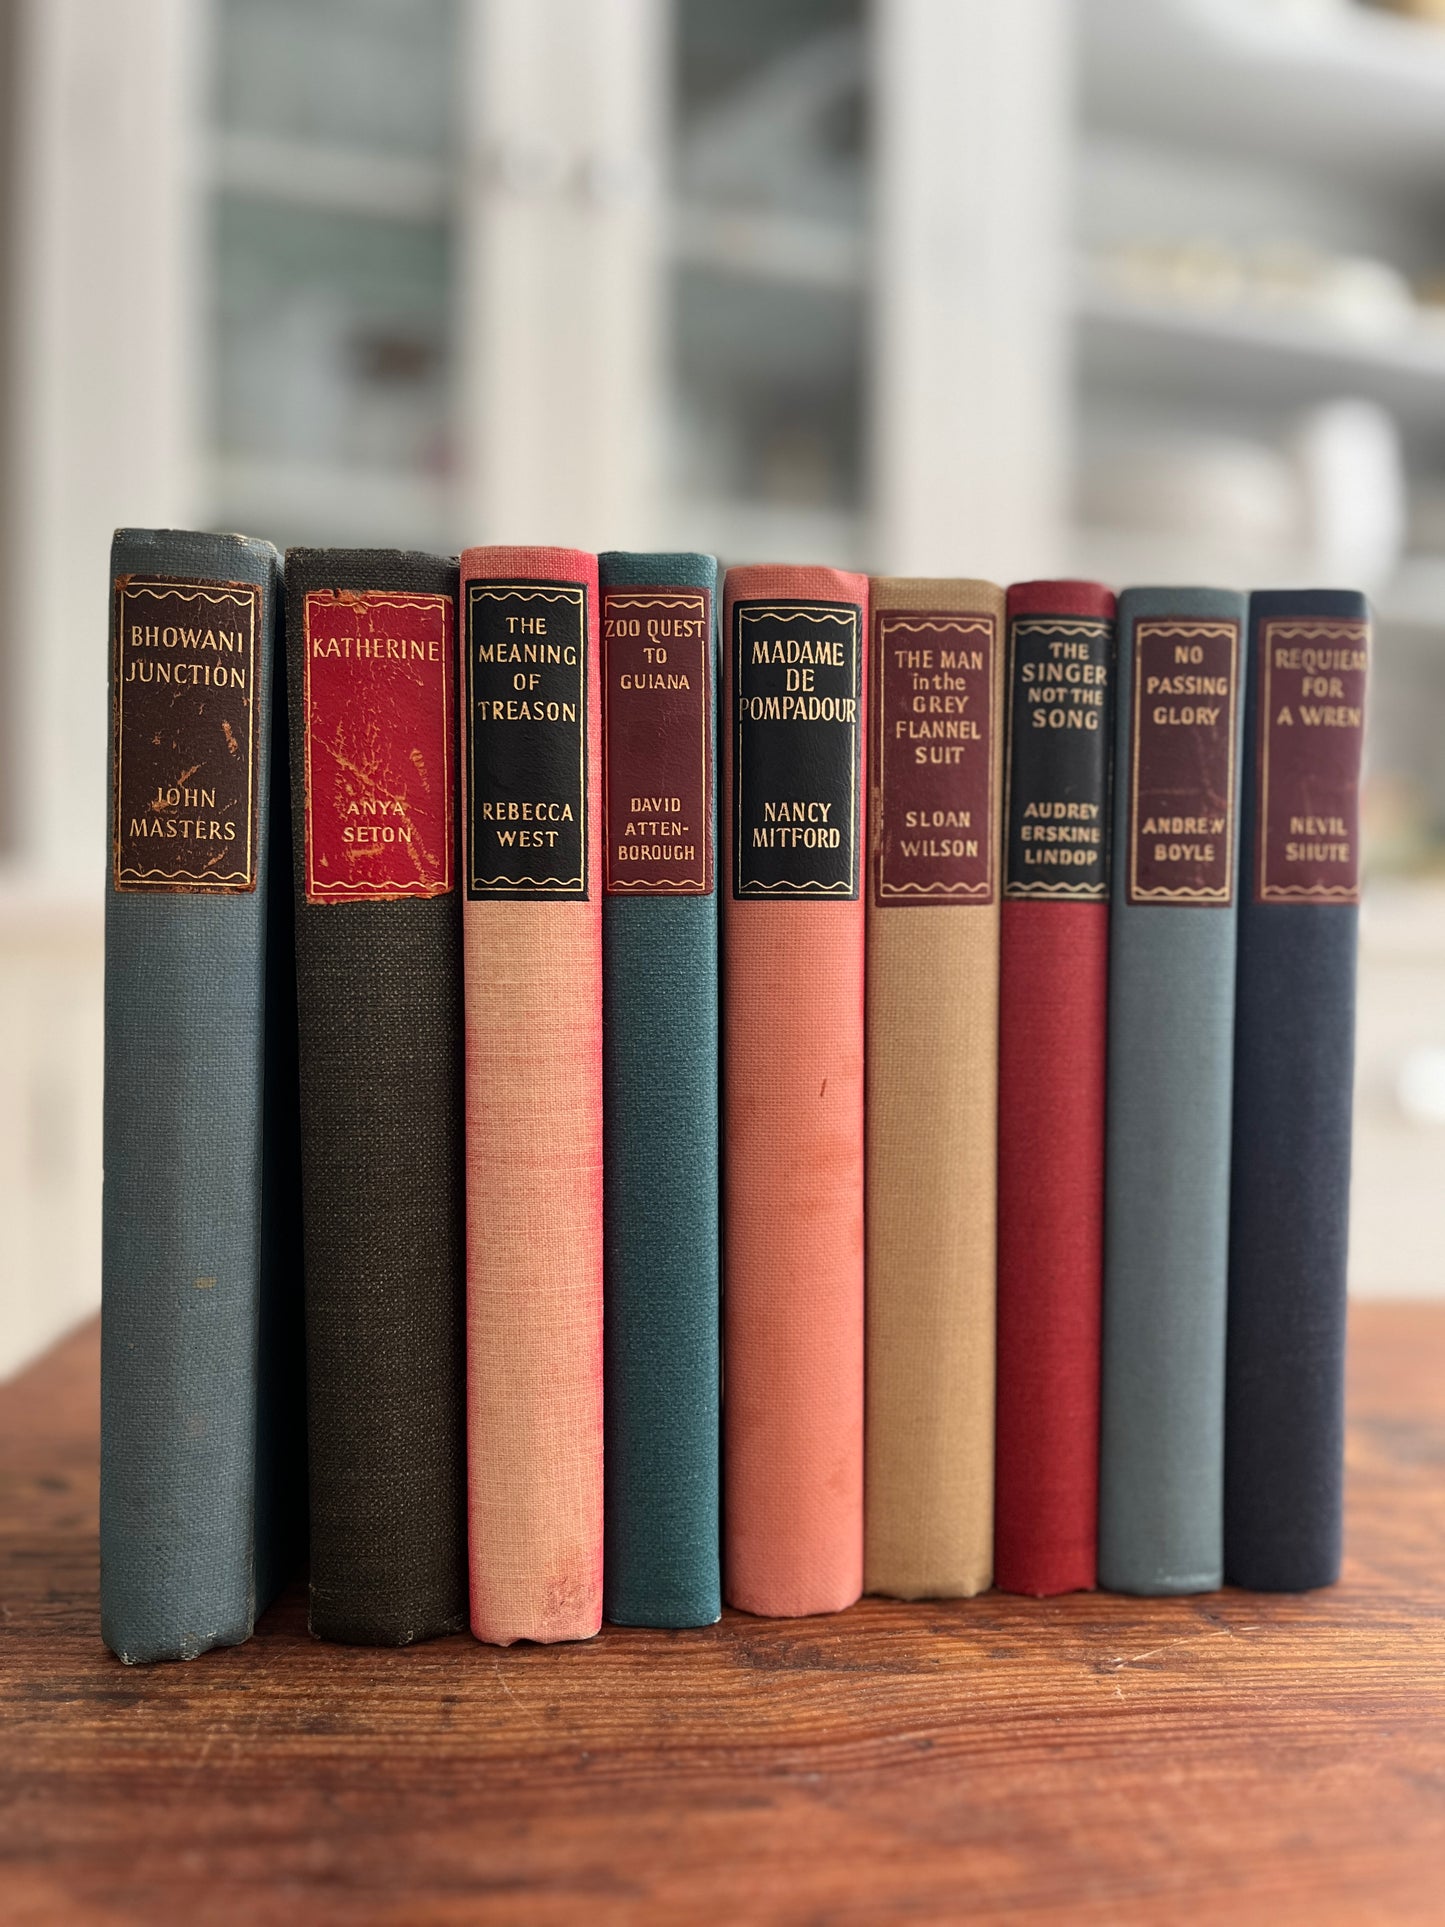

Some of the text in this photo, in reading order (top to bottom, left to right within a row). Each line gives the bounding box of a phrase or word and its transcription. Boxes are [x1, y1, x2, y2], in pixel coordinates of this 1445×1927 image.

[506, 617, 547, 635] THE
[605, 620, 705, 643] ZOO QUEST
[131, 627, 243, 653] BHOWANI
[313, 638, 440, 661] KATHERINE
[479, 644, 576, 665] MEANING
[643, 648, 667, 663] TO
[752, 640, 844, 666] MADAME
[894, 650, 983, 670] THE MAN
[1049, 642, 1090, 660] THE
[1175, 646, 1203, 664] NO
[1276, 648, 1366, 674] REQUIEM
[126, 663, 245, 688] JUNCTION
[513, 674, 541, 690] OF
[621, 674, 690, 689] GUIANA
[786, 668, 814, 692] DE
[913, 672, 966, 691] in the
[1022, 663, 1107, 685] SINGER
[1147, 676, 1228, 696] PASSING
[1302, 676, 1344, 698] FOR
[913, 696, 968, 714] GREY
[1028, 687, 1104, 706] NOT THE
[478, 701, 576, 722] TREASON
[739, 697, 856, 723] POMPADOUR
[1032, 709, 1098, 730] SONG
[1153, 707, 1220, 726] GLORY
[1276, 706, 1360, 728] A WREN
[896, 721, 981, 740] FLANNEL
[915, 747, 964, 764] SUIT
[156, 787, 215, 807] JOHN
[631, 798, 681, 812] DAVID
[347, 801, 405, 816] ANYA
[483, 803, 573, 821] REBECCA
[764, 802, 831, 823] NANCY
[1024, 802, 1098, 819] AUDREY
[624, 822, 689, 836] ATTEN-
[906, 811, 970, 828] SLOAN
[1142, 817, 1224, 834] ANDREW
[1290, 816, 1347, 835] NEVIL
[130, 819, 236, 840] MASTERS
[343, 826, 412, 843] SETON
[753, 828, 840, 848] MITFORD
[1021, 826, 1100, 844] ERSKINE
[497, 831, 559, 848] WEST
[901, 839, 978, 857] WILSON
[618, 845, 695, 860] BOROUGH
[1024, 849, 1098, 866] LINDOP
[1154, 844, 1215, 862] BOYLE
[1286, 842, 1350, 862] SHUTE
